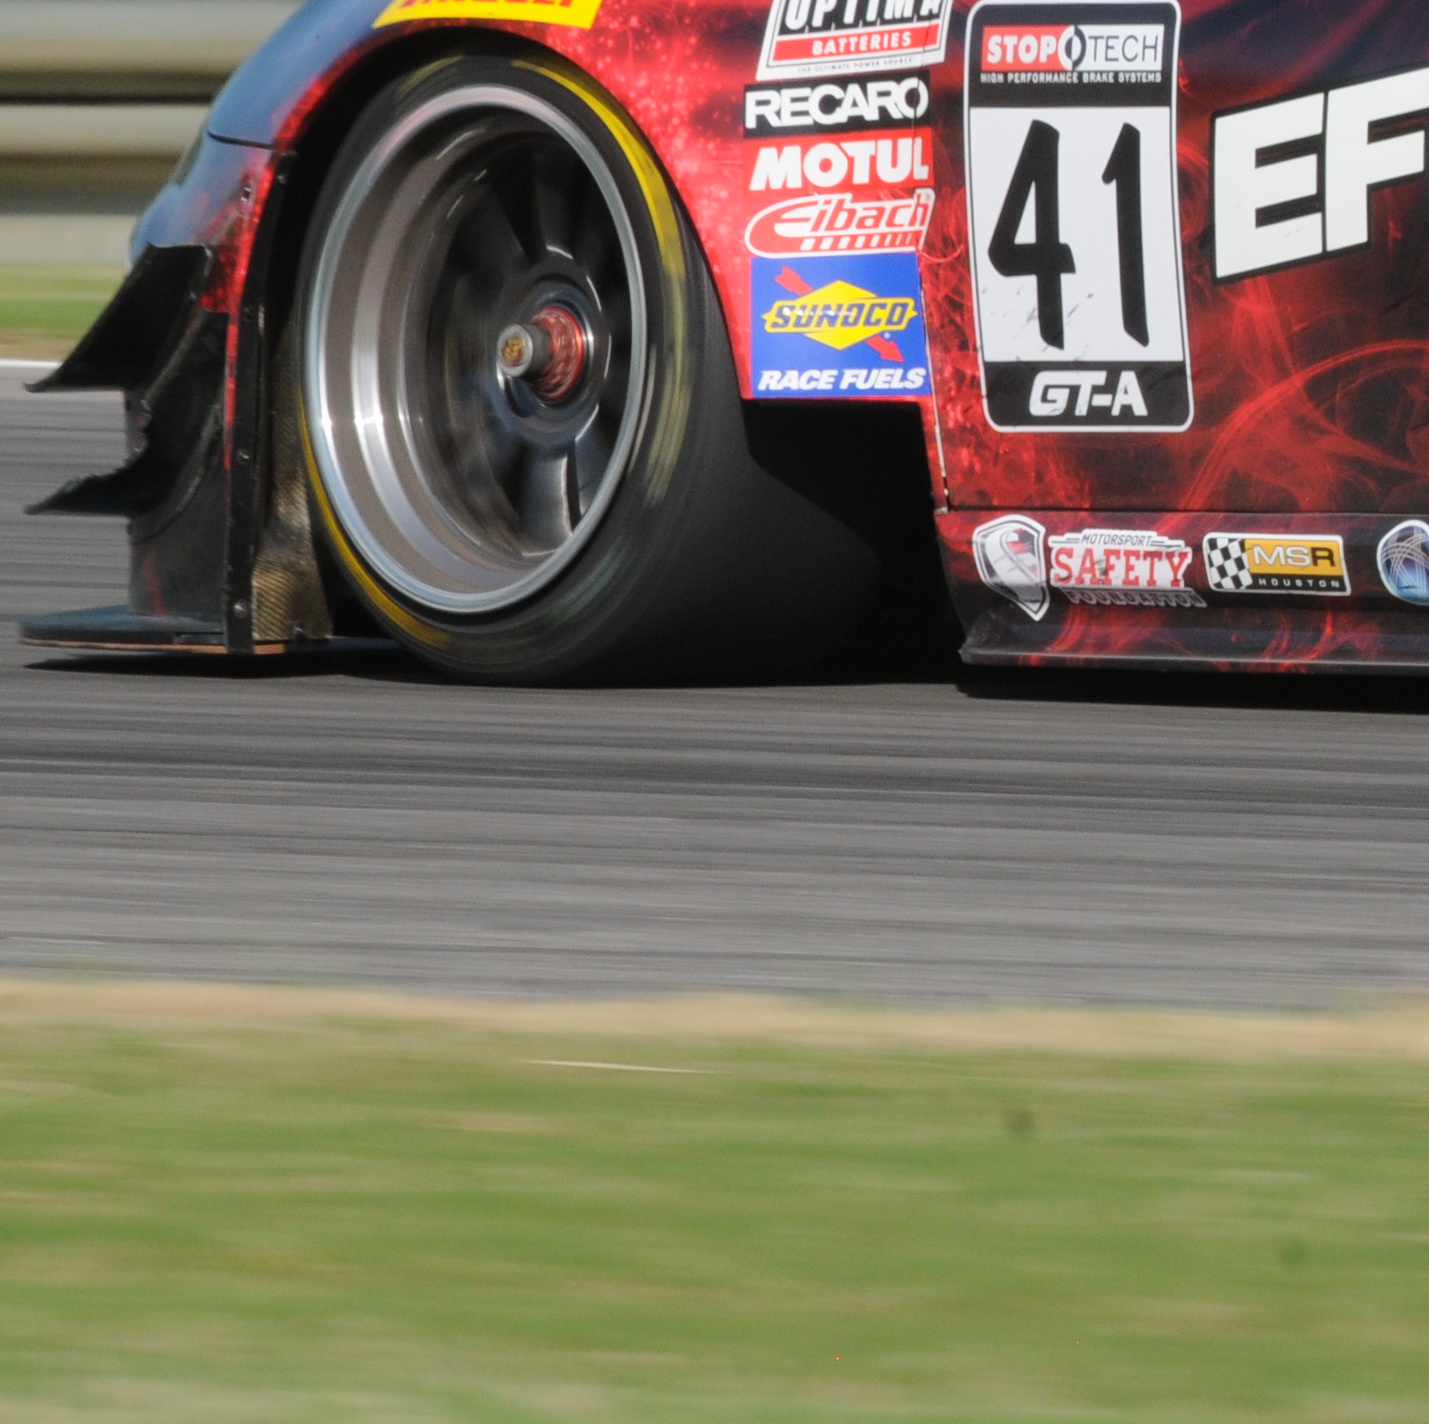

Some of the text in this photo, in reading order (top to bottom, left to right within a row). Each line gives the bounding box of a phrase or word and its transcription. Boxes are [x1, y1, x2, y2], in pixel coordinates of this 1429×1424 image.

[811, 31, 913, 57] BATTERIES
[980, 72, 1162, 84] HIGH PERFORMANCE BRAKE SYSTEMS
[745, 77, 929, 129] RECARO
[749, 137, 930, 191] MOTUL
[747, 192, 930, 255] Eibach
[988, 119, 1150, 350] 41
[770, 302, 910, 329] SUNOCO
[757, 366, 927, 391] RACE FUELS
[1029, 371, 1148, 416] GT-A
[1081, 534, 1153, 547] MOTORSPORT
[1053, 547, 1190, 589] SAFETY
[1252, 544, 1336, 568] MSR
[1258, 577, 1341, 590] HOUSTON
